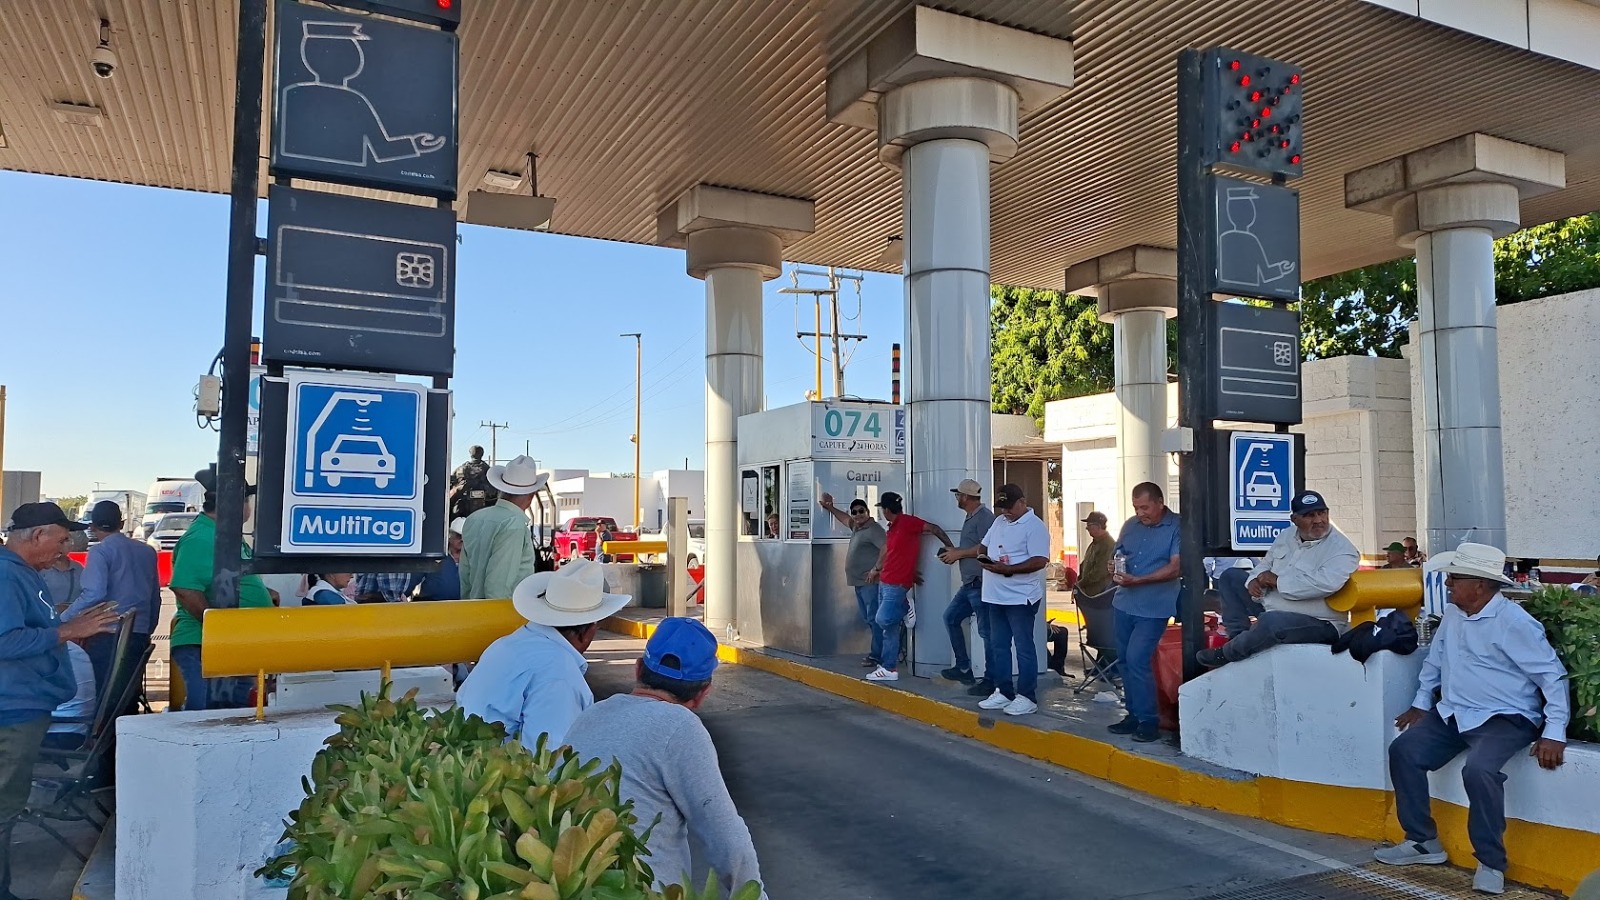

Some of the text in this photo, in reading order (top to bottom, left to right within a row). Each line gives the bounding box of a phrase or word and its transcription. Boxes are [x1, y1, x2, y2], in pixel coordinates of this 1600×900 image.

[824, 409, 882, 438] 074
[864, 442, 888, 451] HORAS
[846, 469, 882, 482] Carril
[298, 514, 405, 541] MultiTag
[1239, 525, 1286, 538] MultiTa
